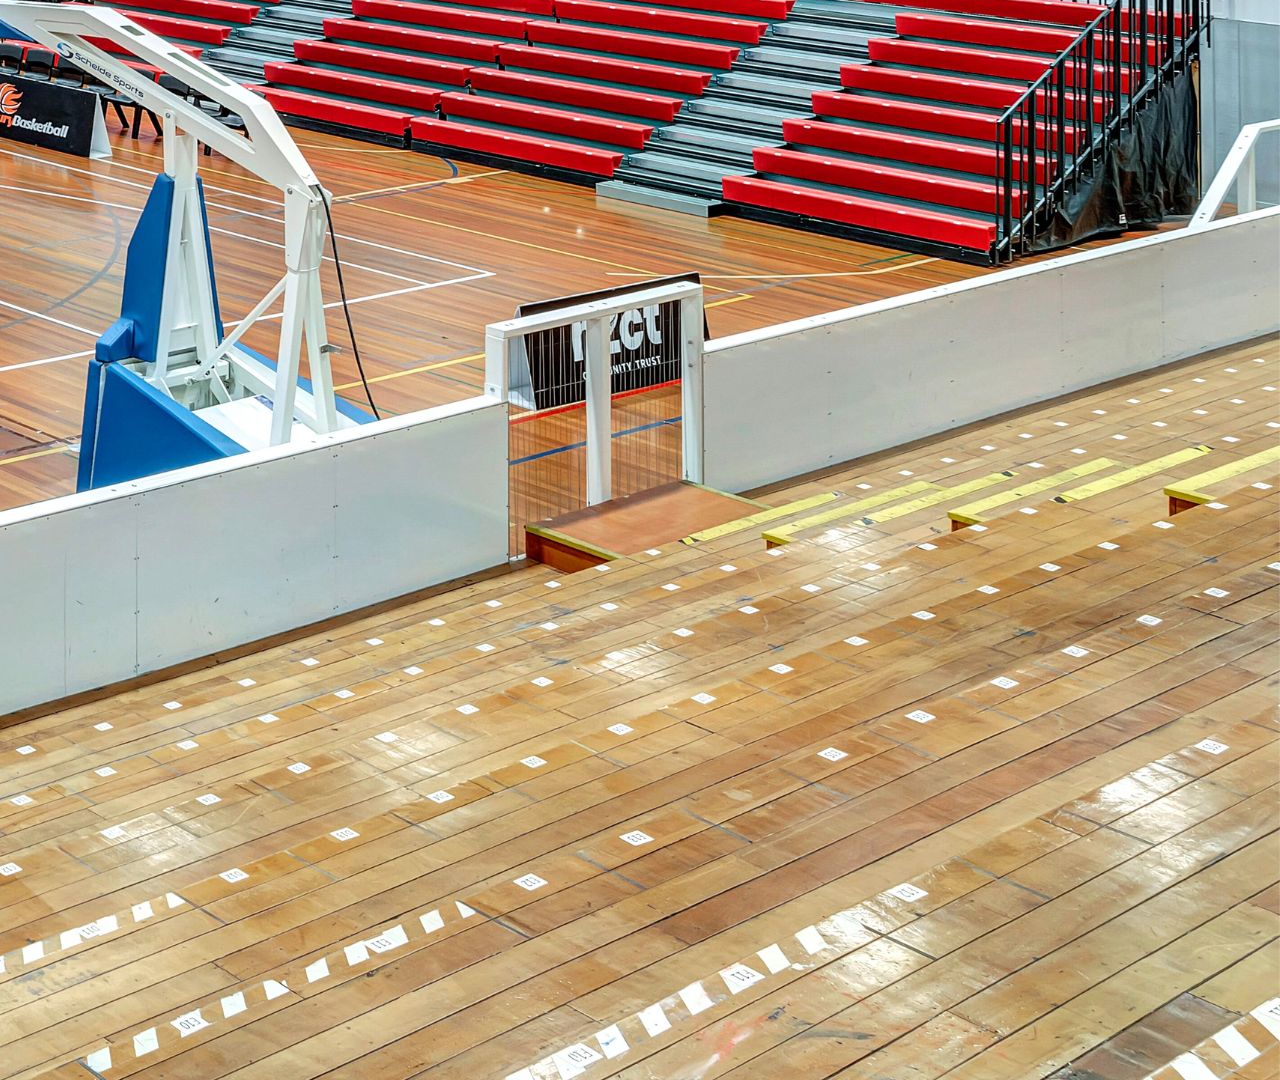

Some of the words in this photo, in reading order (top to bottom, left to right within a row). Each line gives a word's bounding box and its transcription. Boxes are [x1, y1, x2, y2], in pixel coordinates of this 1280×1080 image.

[75, 52, 112, 78] Schelde
[113, 74, 144, 98] Sports
[583, 361, 633, 381] CUNITY
[635, 355, 661, 369] TRUST
